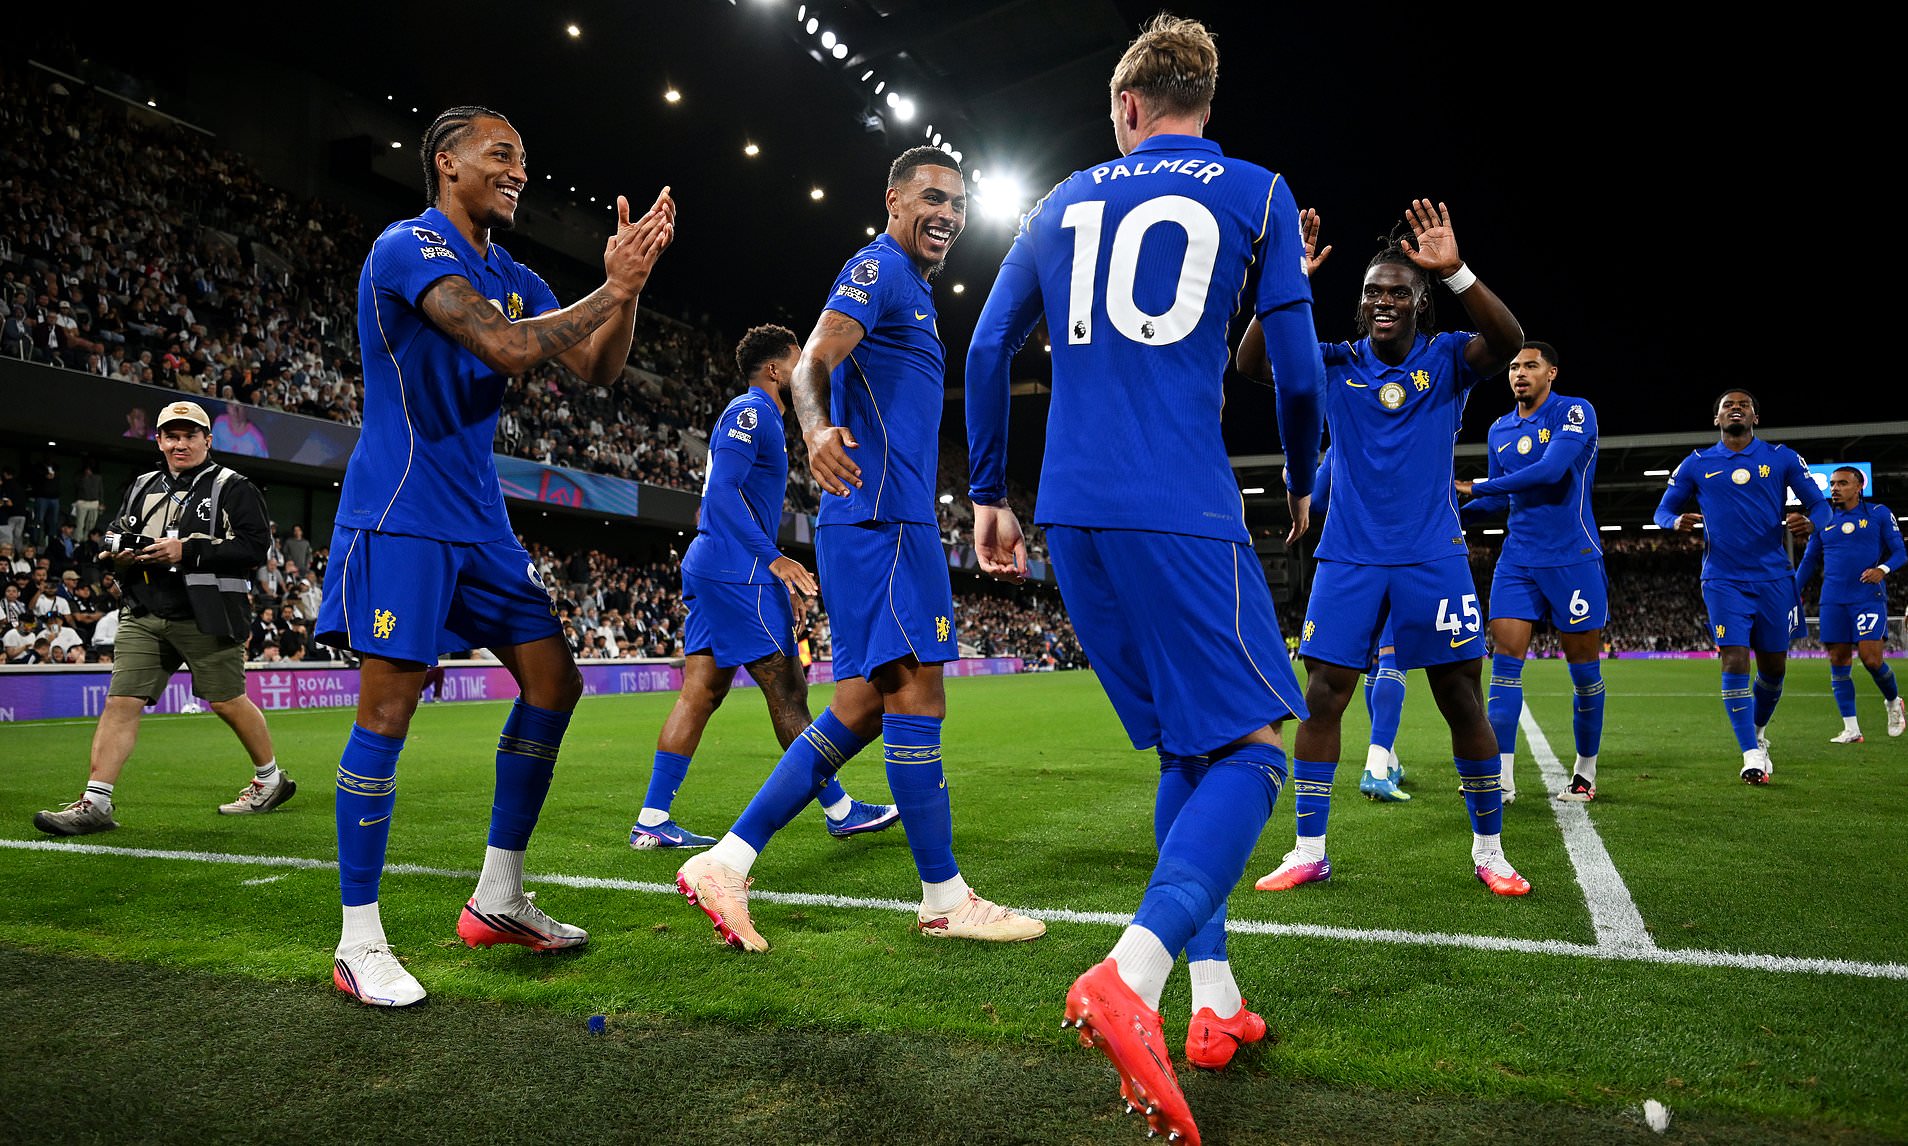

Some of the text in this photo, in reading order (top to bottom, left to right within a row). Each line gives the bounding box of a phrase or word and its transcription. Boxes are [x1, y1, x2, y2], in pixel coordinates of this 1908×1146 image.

[1092, 159, 1225, 185] PALMER
[1061, 194, 1220, 346] 10
[1435, 593, 1480, 636] 45
[1570, 589, 1589, 617] 6
[1857, 613, 1879, 631] 27
[297, 677, 344, 692] ROYAL
[459, 676, 487, 699] TIME
[82, 686, 108, 716] IT'
[298, 694, 360, 709] CARIBBE
